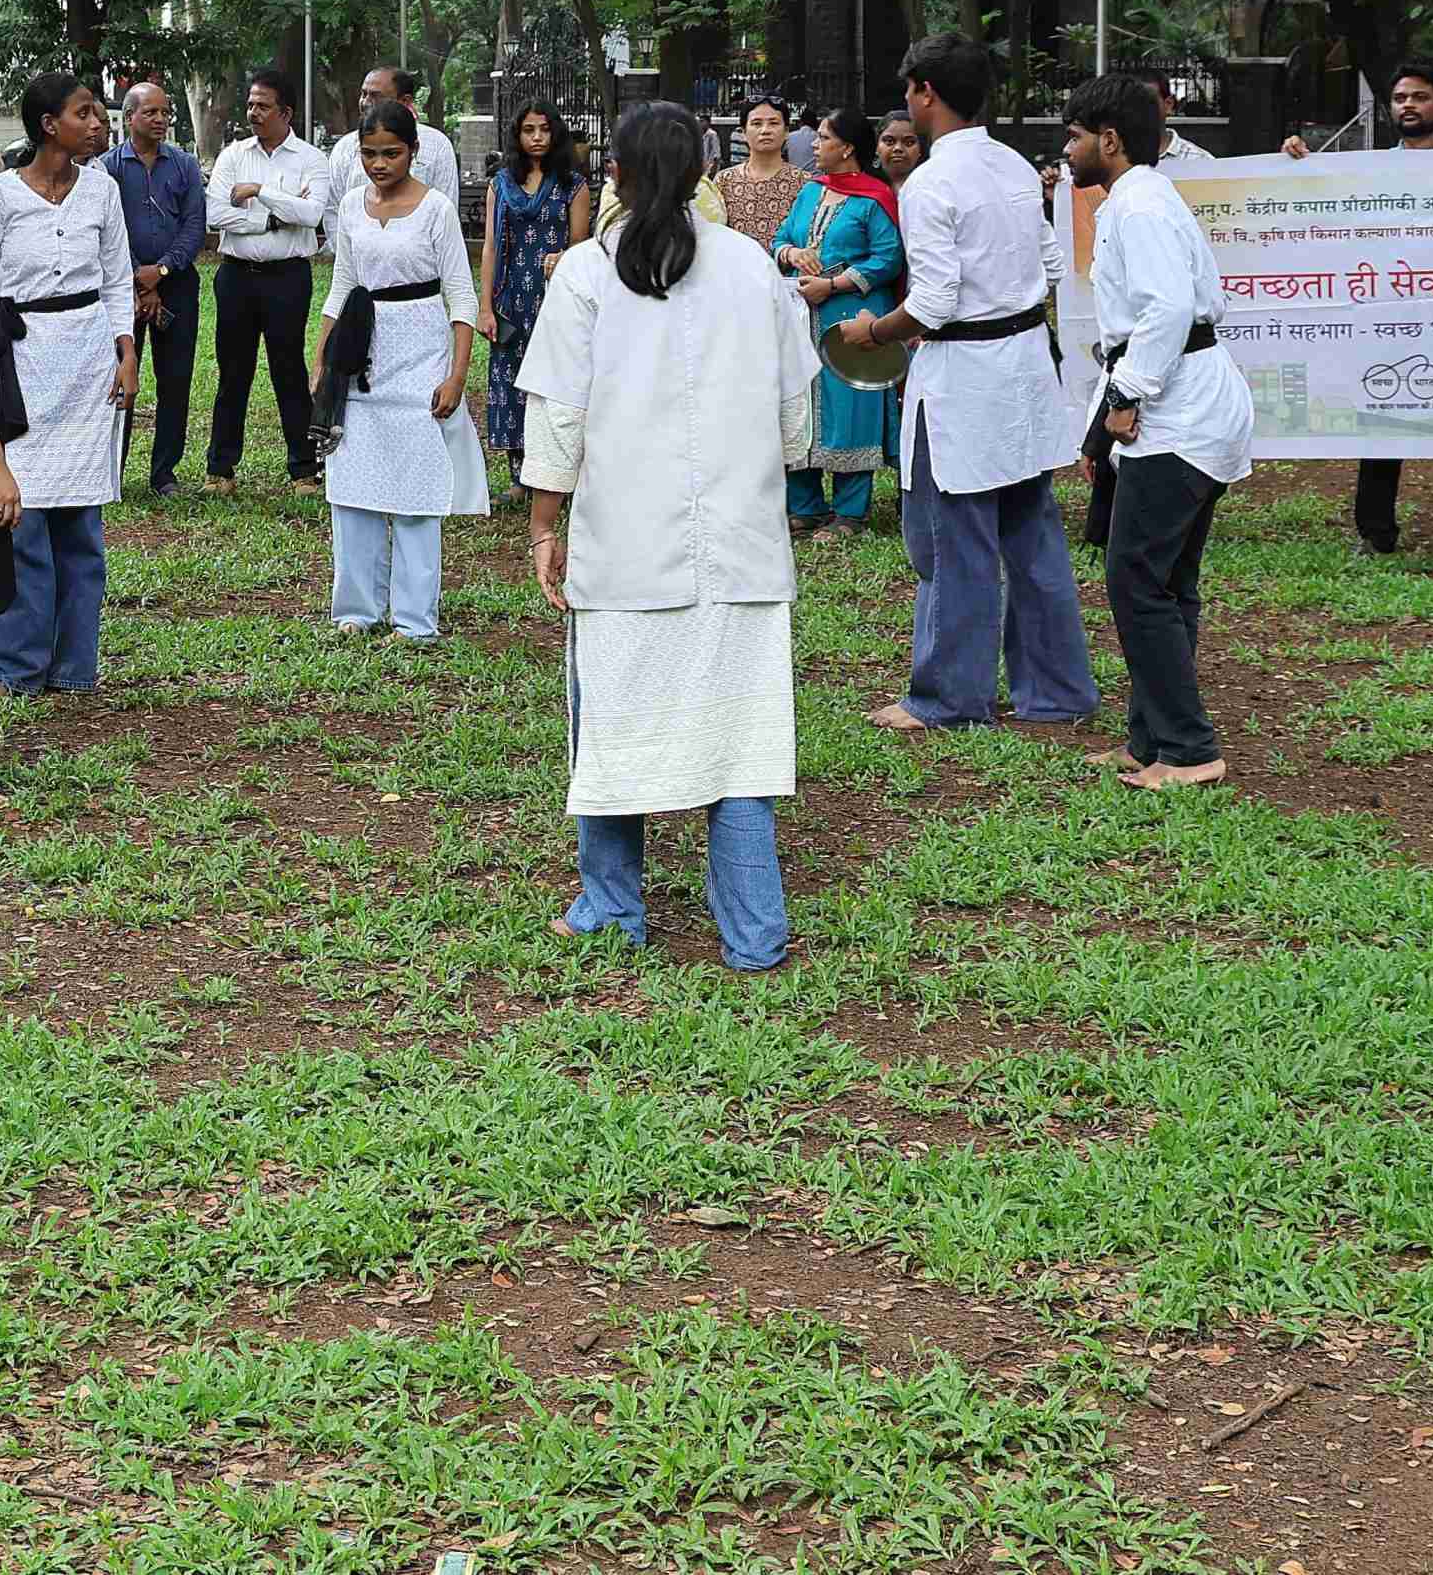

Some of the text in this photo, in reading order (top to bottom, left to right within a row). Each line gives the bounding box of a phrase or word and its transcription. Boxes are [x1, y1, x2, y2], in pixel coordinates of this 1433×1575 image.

[1292, 200, 1337, 214] कपास
[1341, 192, 1416, 212] प्रौद्योगिकी
[1310, 225, 1351, 241] किसान
[1355, 227, 1401, 239] कल्याण
[1219, 273, 1336, 300] स्वच्छता
[1345, 262, 1379, 303] ही
[1267, 319, 1283, 340] में
[1289, 323, 1353, 343] सहभाग
[1373, 322, 1423, 338] स्वच्छ
